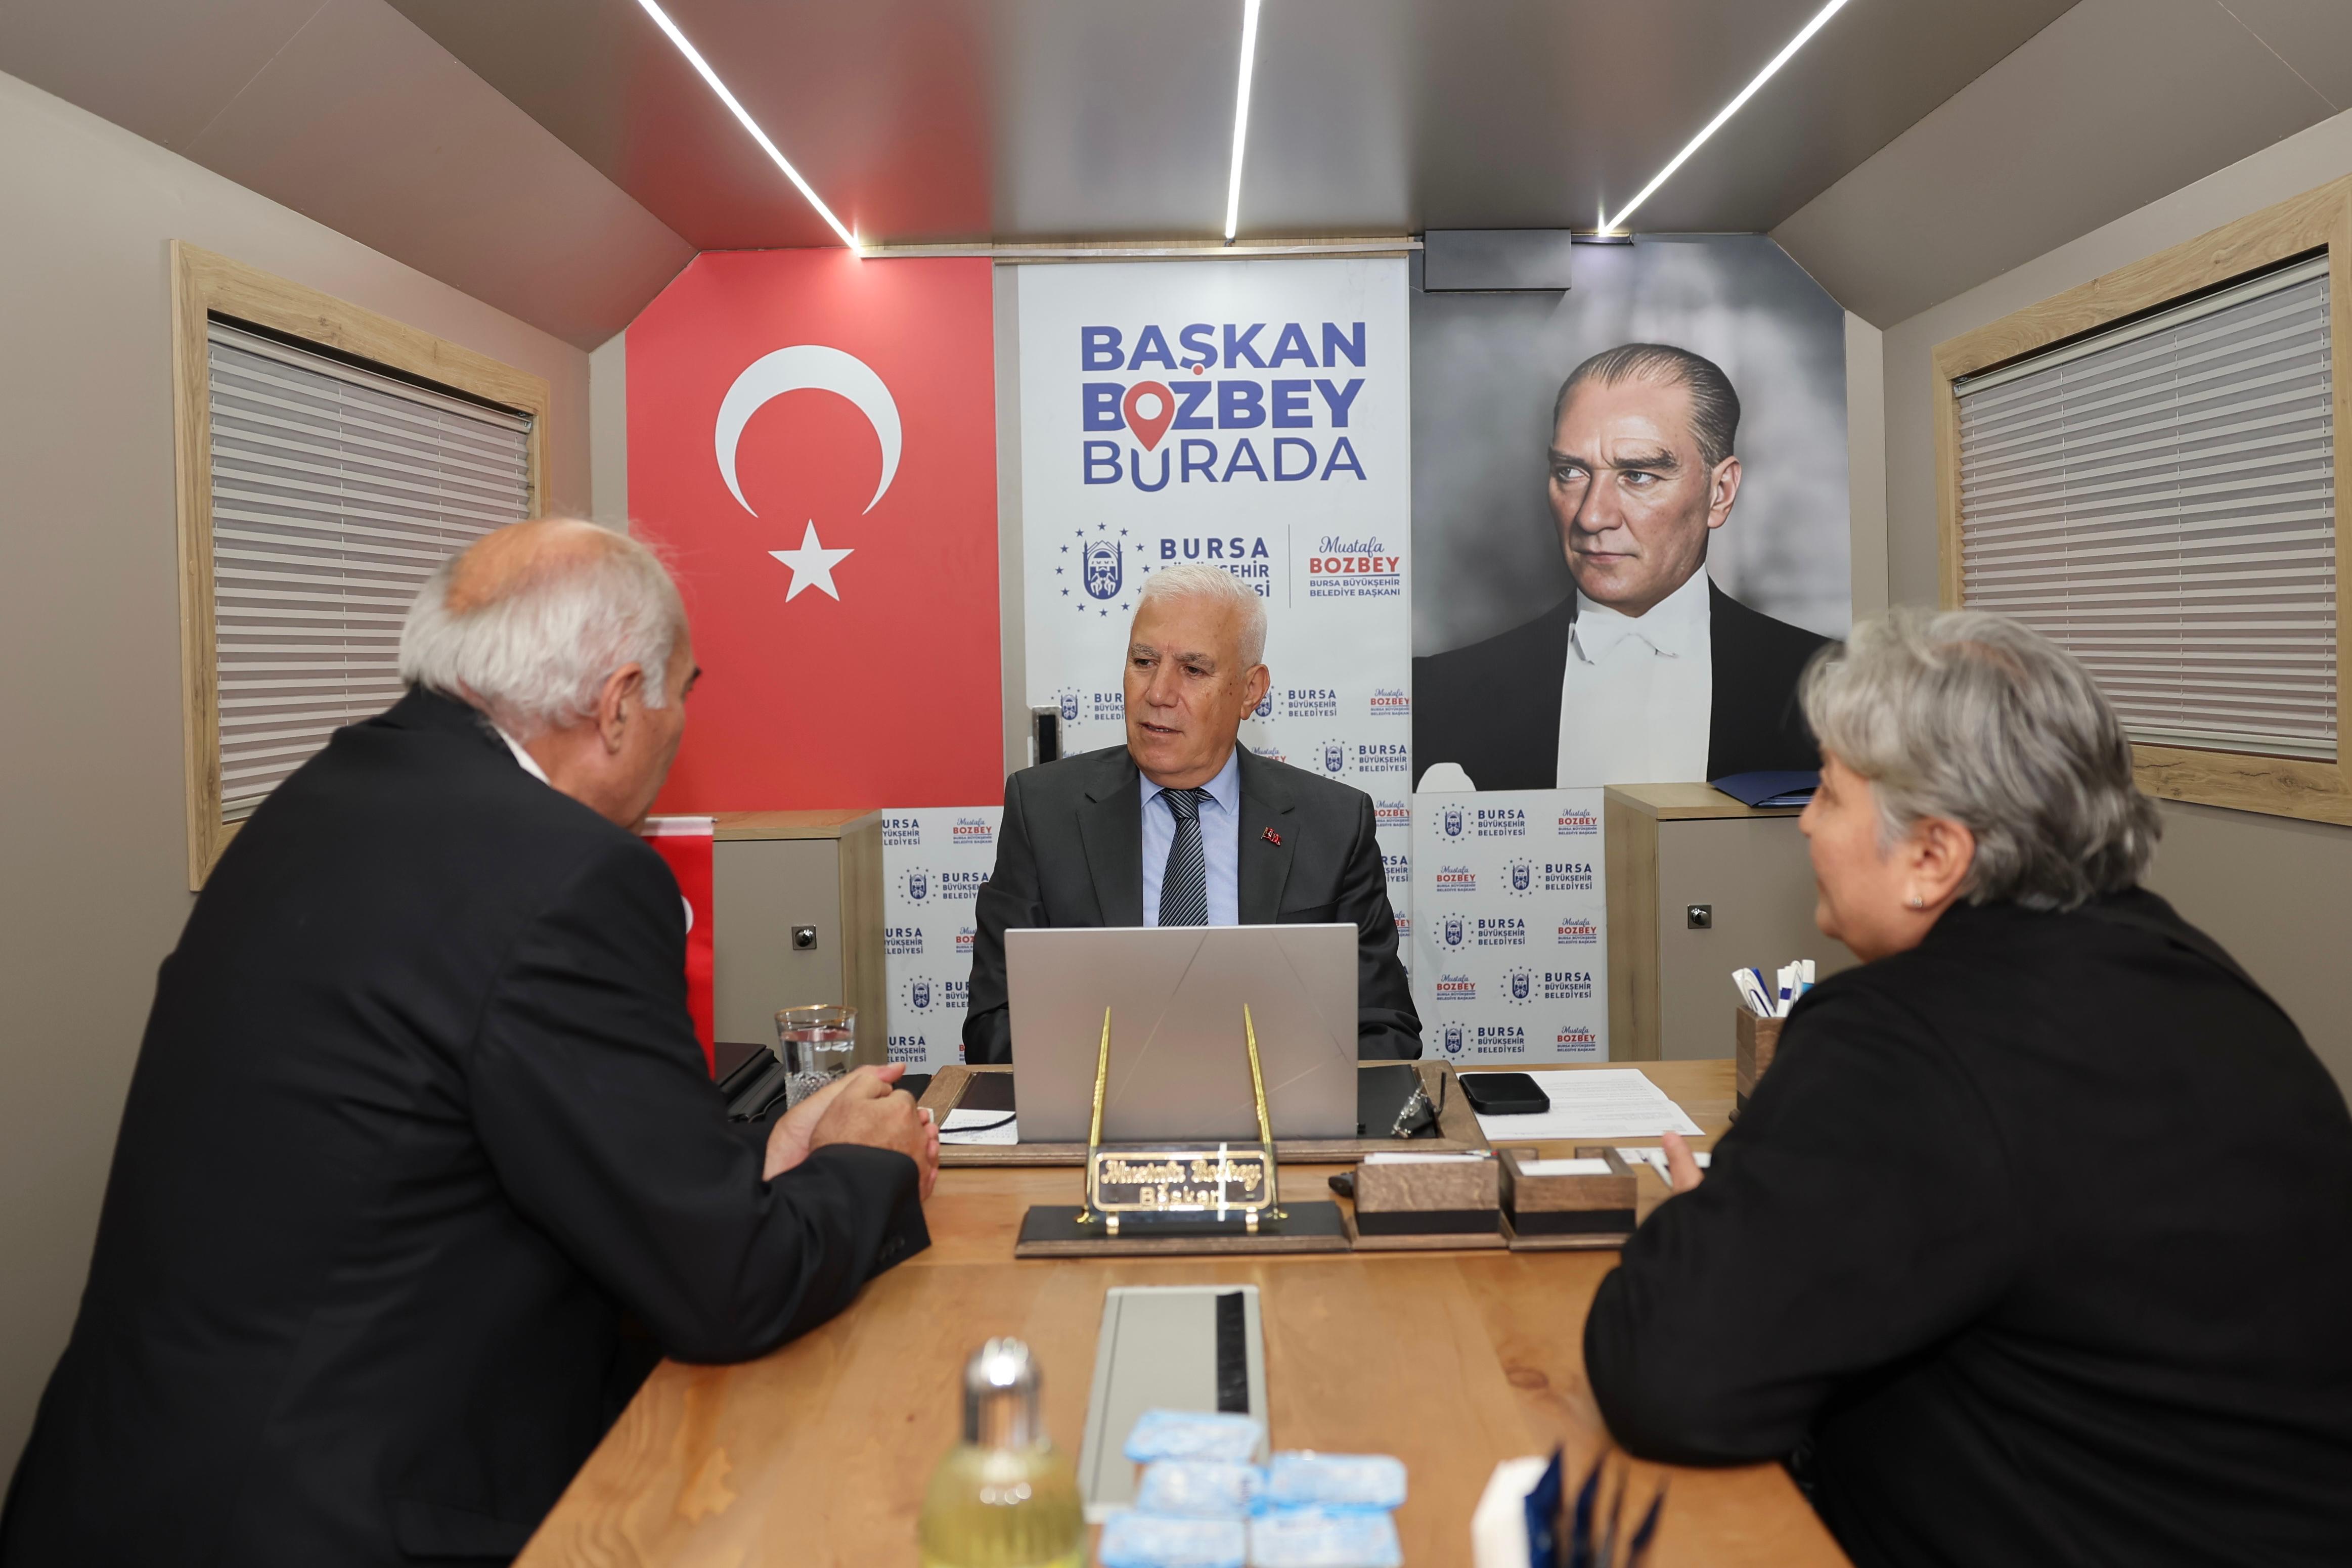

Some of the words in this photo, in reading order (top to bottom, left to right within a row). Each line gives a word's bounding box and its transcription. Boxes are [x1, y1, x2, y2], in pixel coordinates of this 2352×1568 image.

[1081, 322, 1366, 375] BAŞKAN
[1082, 378, 1366, 452] BOZBEY
[1083, 436, 1367, 492] BURADA
[1161, 537, 1269, 560] BURSA
[1319, 535, 1385, 558] Mustafa
[1310, 556, 1400, 573] BOZBEY
[1343, 577, 1400, 588] BÜYÜKŞEHİR
[1310, 588, 1356, 597] BELEDİYE
[1358, 588, 1400, 598] BAŞKANI
[1095, 693, 1122, 702] BUR
[1289, 689, 1336, 699] BURSA
[1289, 699, 1336, 708] BÜYÜKŞEHİR
[1095, 712, 1124, 720] BELEDİ
[1289, 708, 1337, 716] BELEDİYESİ
[1359, 745, 1407, 754] BURSA
[1359, 754, 1407, 763] BÜYÜKŞEHİR
[1359, 763, 1407, 772] BELEDİYESİ
[1478, 810, 1525, 819] BURSA
[1562, 809, 1590, 818] Mustafa
[882, 819, 919, 828] URSA
[957, 818, 985, 827] Mustafa
[1478, 819, 1525, 828] BÜYÜKŞEHİR
[882, 829, 919, 837] YÜKŞEHİR
[1478, 828, 1525, 836] BELEDİYESİ
[883, 837, 920, 845] LEDİYESİ
[1382, 856, 1408, 865] RSA
[1386, 865, 1408, 874] ŞEHİR
[1441, 865, 1469, 874] Mustafa
[1545, 864, 1592, 873] BURSA
[943, 873, 989, 882] BURSA
[1387, 874, 1408, 882] İYESİ
[1545, 873, 1592, 882] BÜYÜKŞEHİR
[943, 882, 979, 891] BÜYÜKŞE
[1545, 881, 1592, 890] BELEDİYESİ
[943, 890, 977, 899] BELEDİY
[1479, 919, 1525, 928] BURSA
[1562, 918, 1590, 927] Mustafa
[886, 928, 922, 937] URSA
[1479, 928, 1525, 937] BÜYÜKŞEHİR
[1479, 937, 1525, 945] BELEDİYESİ
[1441, 974, 1469, 983] Mustafa
[1545, 972, 1591, 981] BURSA
[1545, 981, 1591, 991] BÜYÜKŞEHİR
[1545, 990, 1591, 999] BELEDİYESİ
[1478, 1027, 1524, 1036] BURSA
[1562, 1026, 1589, 1035] Mustafa
[889, 1036, 925, 1045] URSA
[1478, 1036, 1524, 1045] BÜYÜKŞEHİR
[1478, 1045, 1524, 1053] BELEDİYESİ
